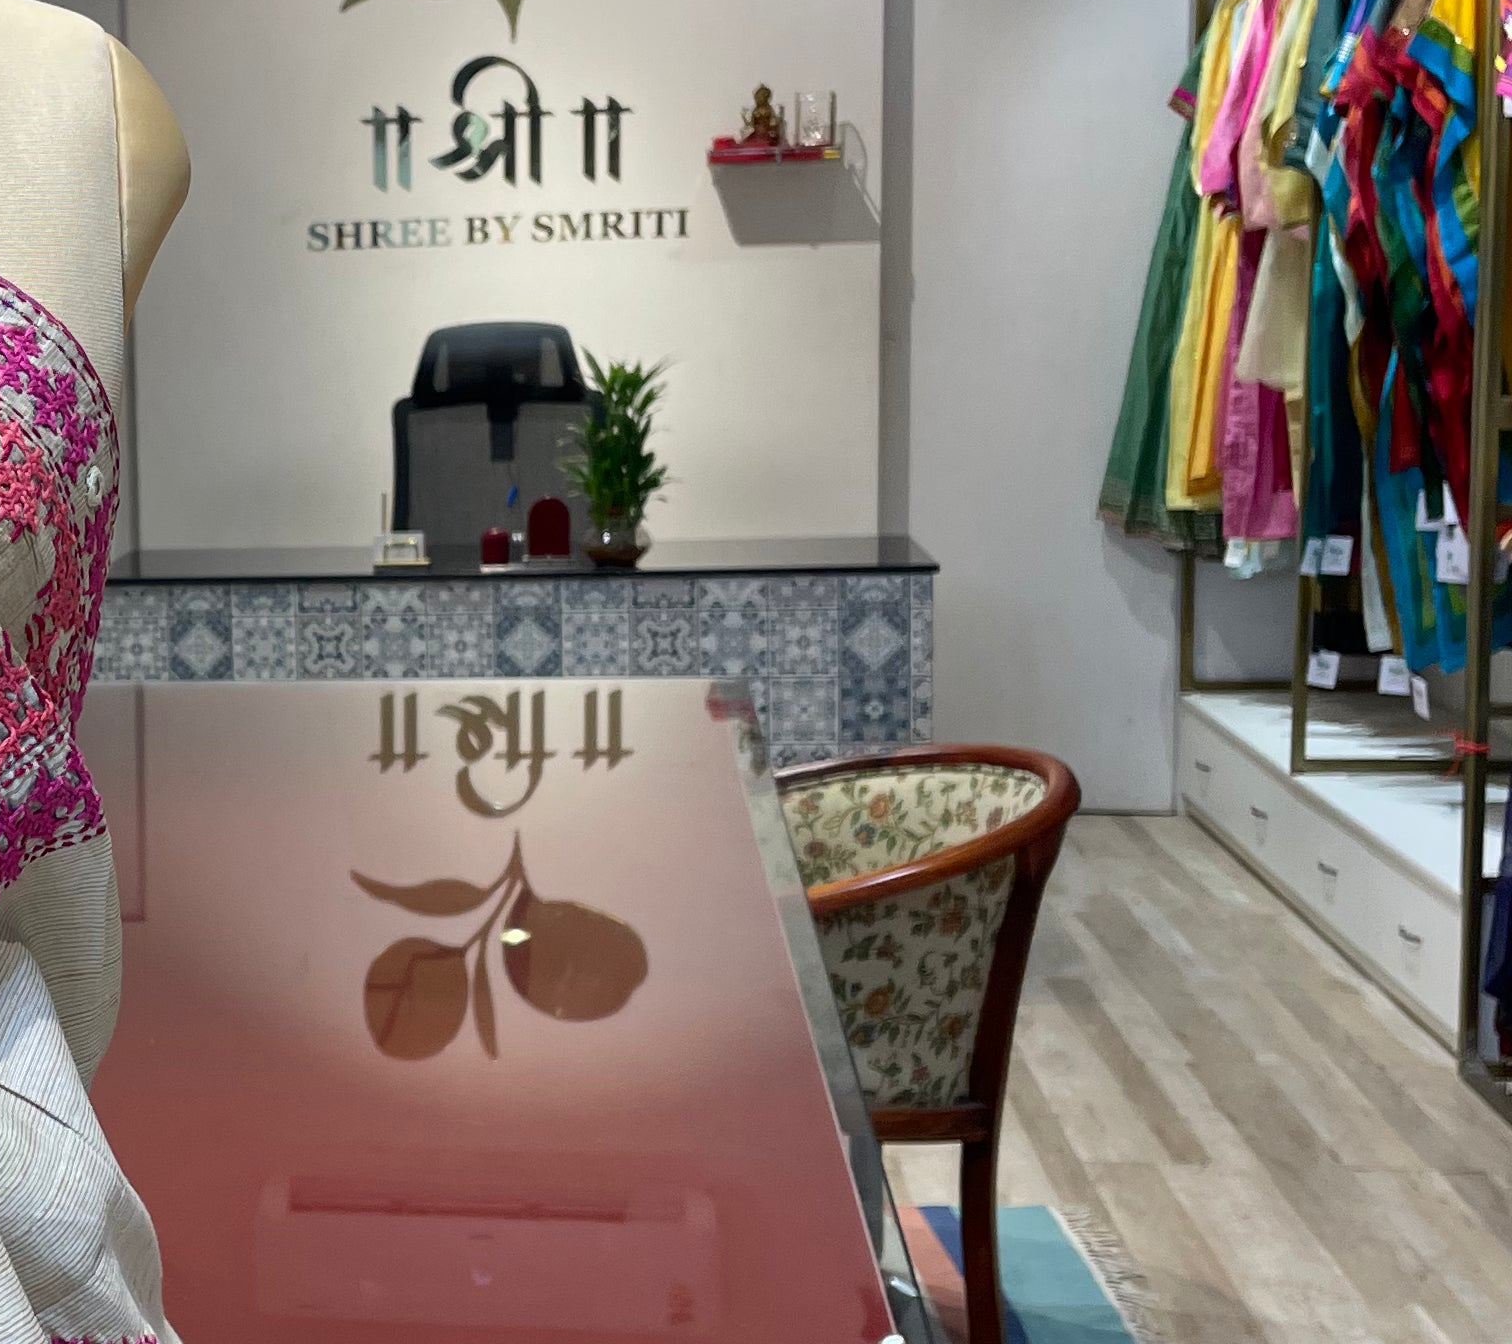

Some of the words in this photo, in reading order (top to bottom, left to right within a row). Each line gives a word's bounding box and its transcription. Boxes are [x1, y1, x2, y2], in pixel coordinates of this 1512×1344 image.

[306, 218, 451, 252] SHREE
[464, 213, 521, 245] BY
[531, 207, 689, 243] SMRITI
